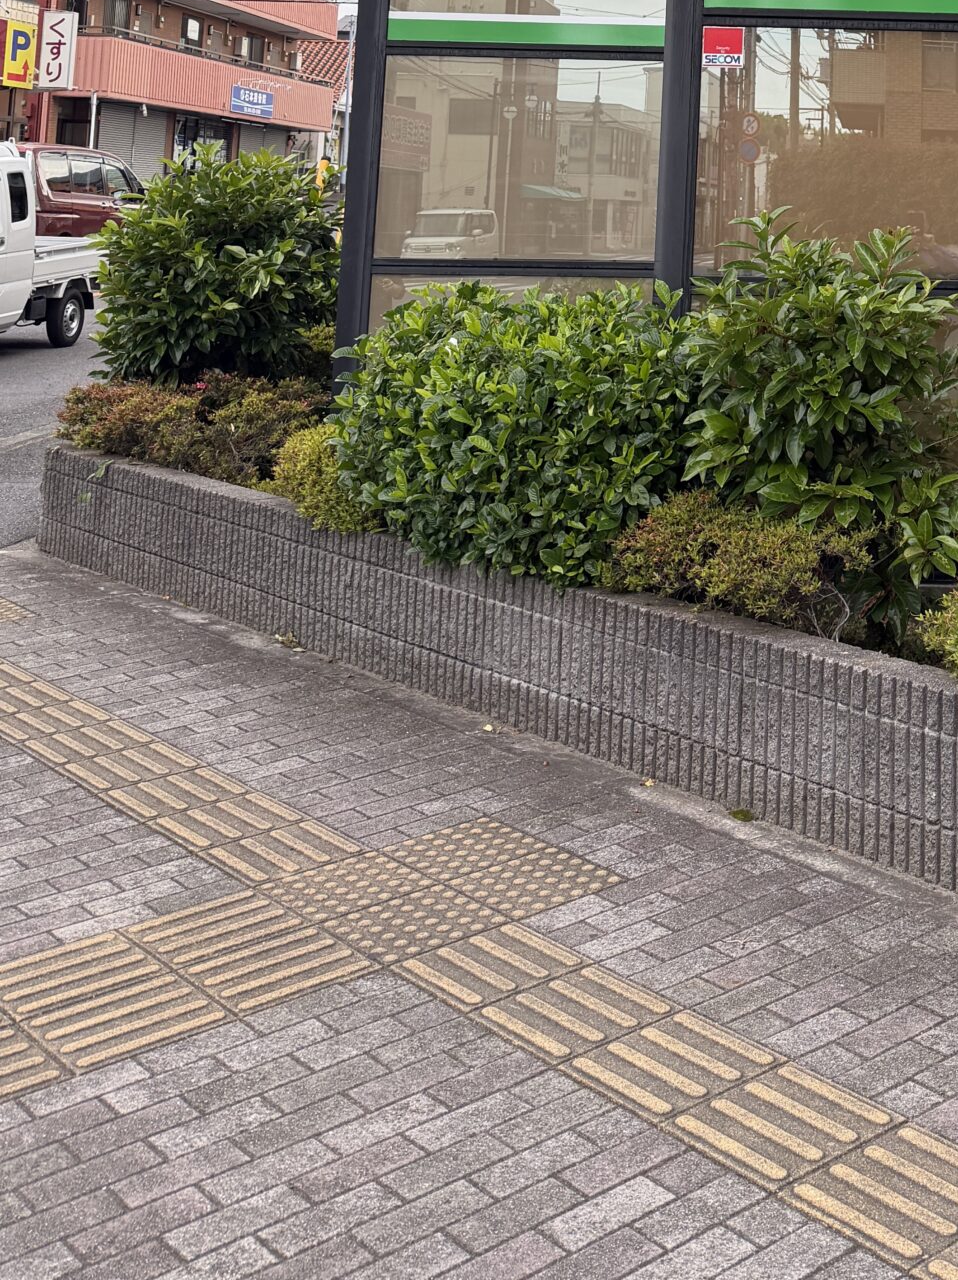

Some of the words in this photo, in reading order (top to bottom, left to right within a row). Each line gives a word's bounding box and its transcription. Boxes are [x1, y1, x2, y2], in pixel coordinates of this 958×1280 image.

[10, 29, 31, 62] P
[45, 17, 67, 83] くすり
[704, 54, 741, 64] SECOM
